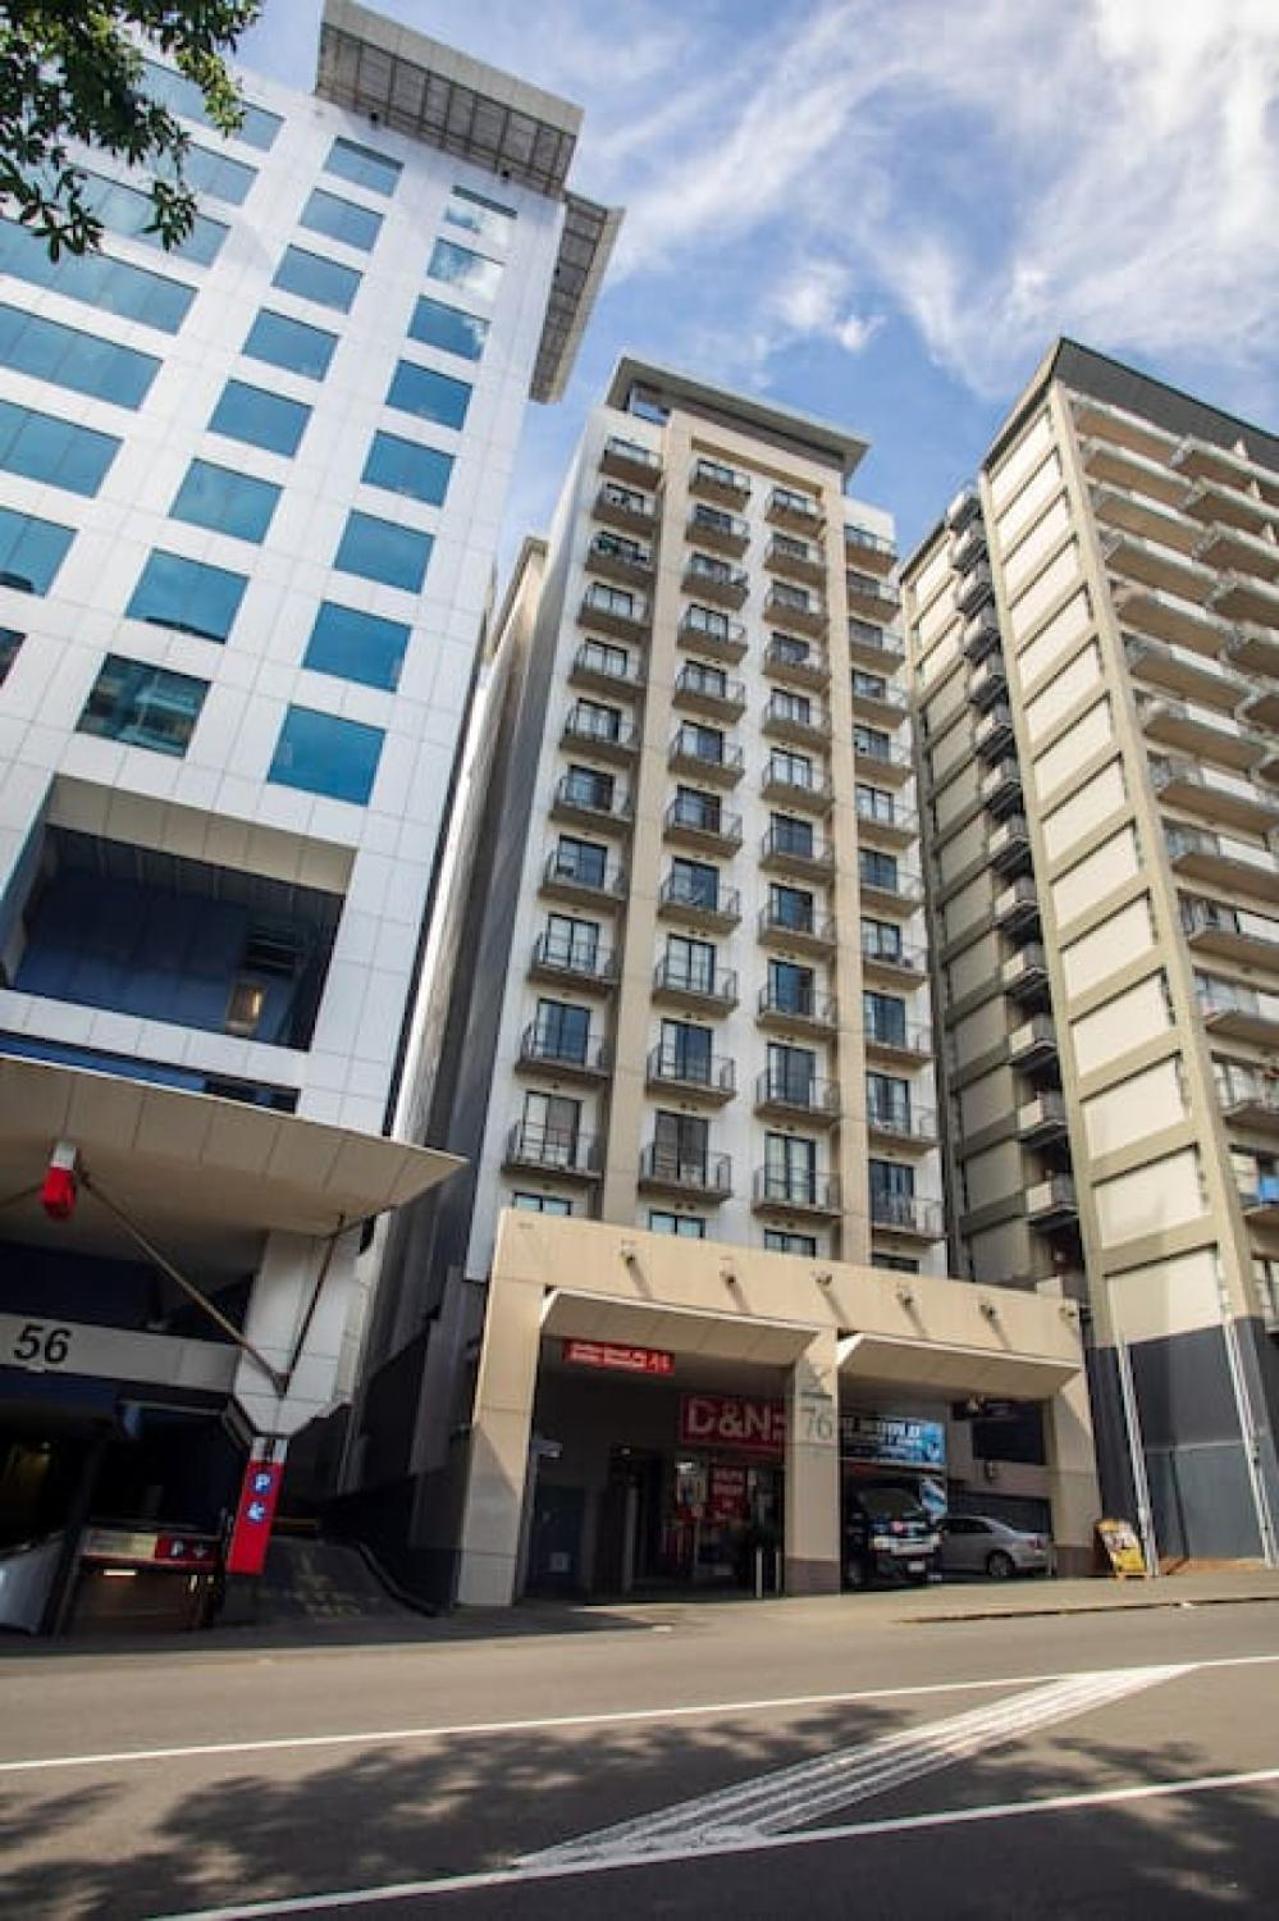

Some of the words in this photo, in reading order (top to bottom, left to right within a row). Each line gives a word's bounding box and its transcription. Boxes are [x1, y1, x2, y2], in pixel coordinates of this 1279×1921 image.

[14, 1324, 71, 1364] 56
[798, 1406, 833, 1441] 76
[256, 1473, 272, 1492] P
